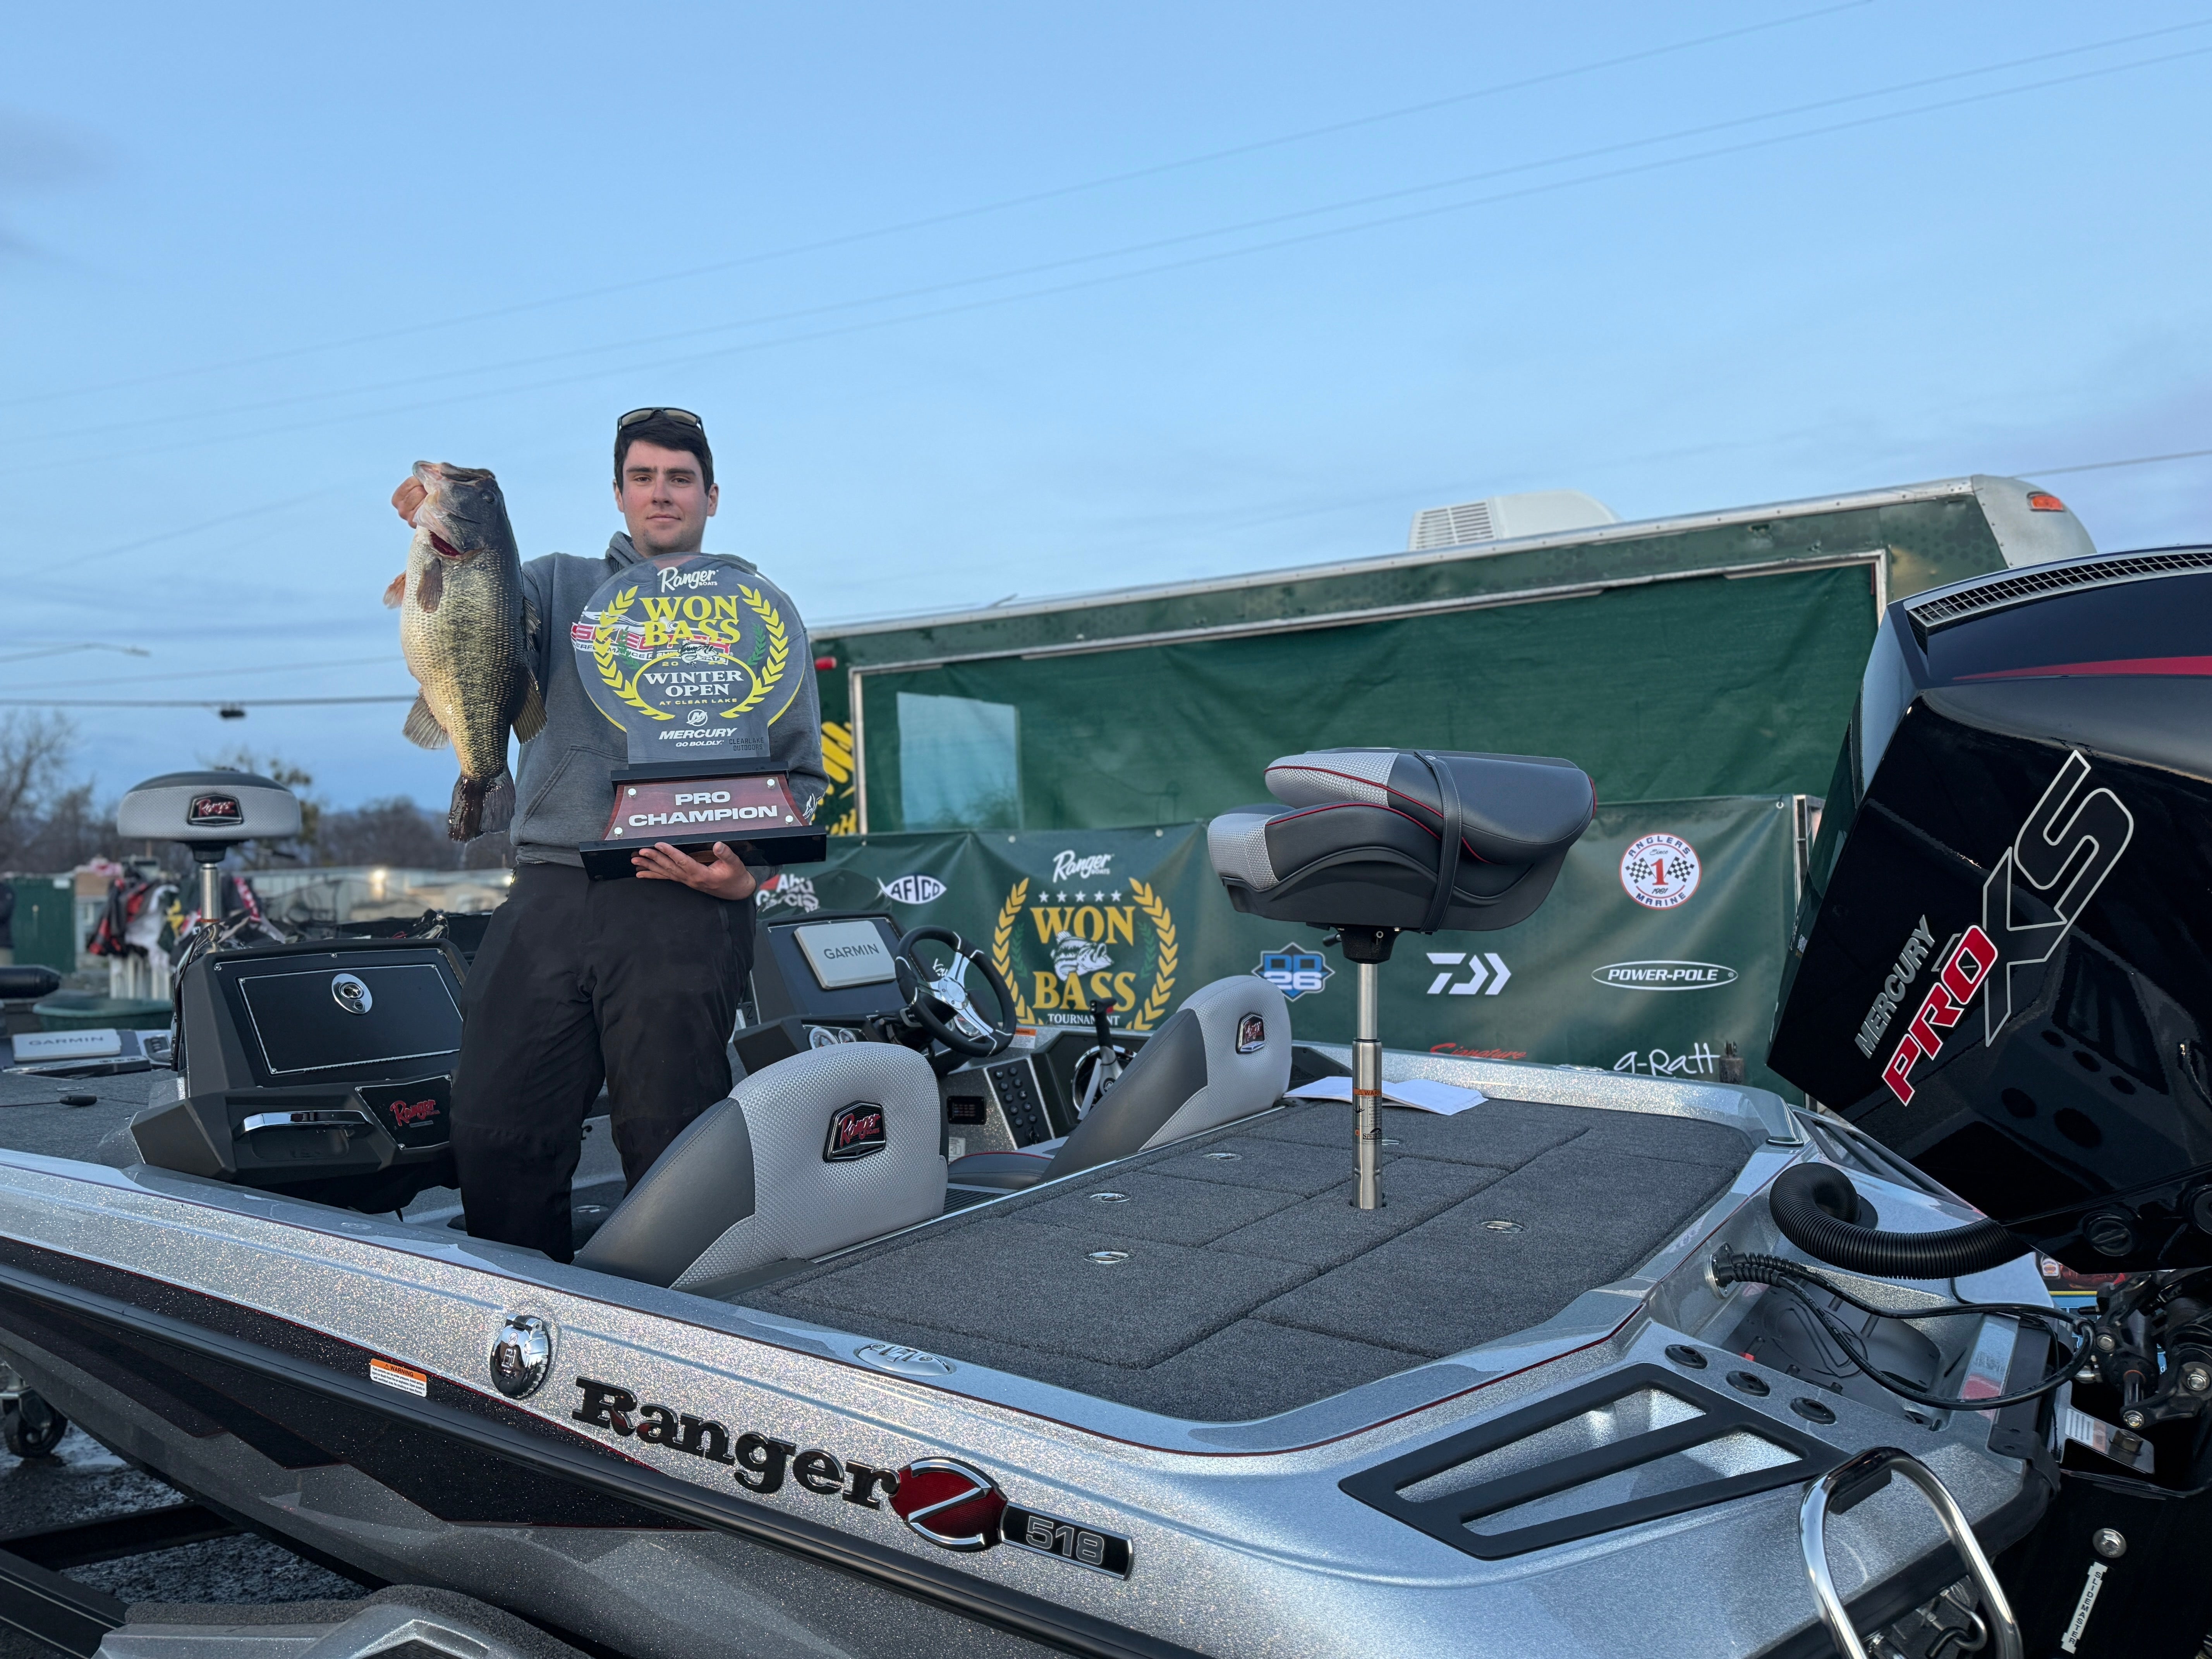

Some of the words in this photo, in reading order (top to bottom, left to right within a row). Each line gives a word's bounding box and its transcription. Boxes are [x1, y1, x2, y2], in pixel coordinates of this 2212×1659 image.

[657, 567, 716, 593] Ranger
[639, 596, 739, 621] WON
[642, 619, 741, 647] BASS
[643, 671, 744, 684] WINTER
[665, 684, 730, 697] OPEN
[659, 728, 737, 740] MERCURY
[675, 791, 730, 806] PRO
[629, 805, 777, 826] CHAMPION
[1628, 836, 1691, 857] ANGLERS
[1053, 850, 1111, 883] Ranger
[1650, 858, 1669, 885] 1
[1635, 892, 1686, 907] MARINE
[1030, 906, 1136, 946] WON
[824, 943, 879, 959] GARMIN
[1264, 971, 1322, 990] 26
[1607, 969, 1719, 981] POWER-POLE
[1854, 914, 1936, 1059] MERCURY
[1032, 971, 1136, 1012] BASS
[1881, 925, 1998, 1107] PRO
[29, 1036, 103, 1046] GARMIN
[390, 1099, 436, 1127] Ranger
[838, 1113, 881, 1148] Ranger
[390, 1365, 413, 1377] WARNING
[571, 1376, 901, 1510] Ranger
[1025, 1515, 1105, 1565] 518
[2068, 1571, 2101, 1644] SLIDEMASTER
